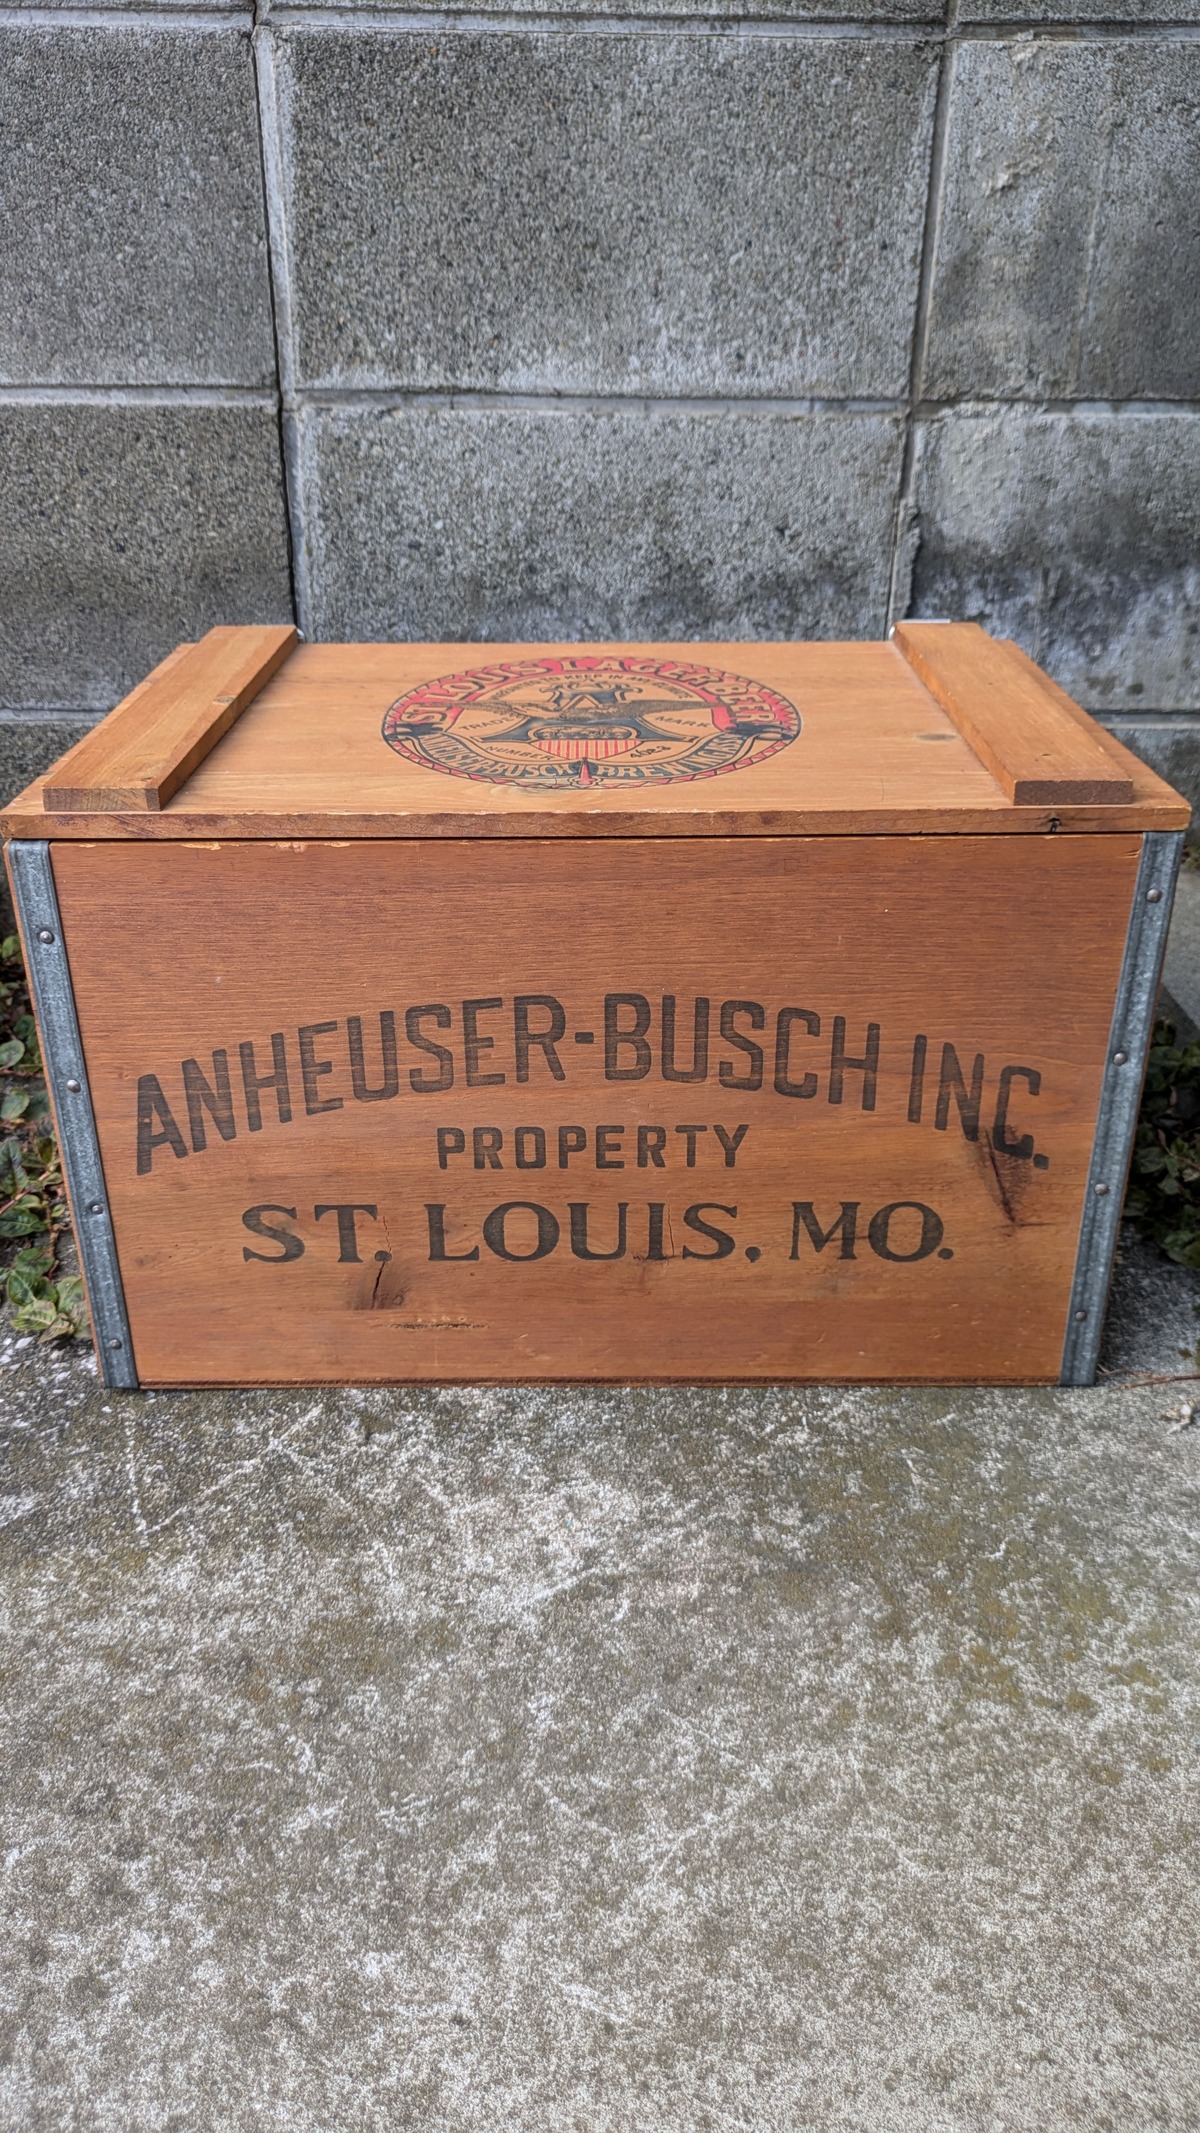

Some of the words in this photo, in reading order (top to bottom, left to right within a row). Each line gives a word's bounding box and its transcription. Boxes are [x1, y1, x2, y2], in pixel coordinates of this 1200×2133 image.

[425, 661, 554, 702] LOUIS
[562, 659, 722, 687] LAGER
[702, 680, 776, 723] BEER
[564, 673, 602, 681] KEEP
[459, 716, 515, 731] TRADE
[654, 716, 711, 728] MARK
[485, 746, 556, 760] NUMBER
[136, 992, 881, 1175] ANHEUSER-BUSCH
[908, 1033, 1049, 1169] INC.
[437, 1124, 750, 1170] PROPERTY
[242, 1204, 392, 1263] ST.
[789, 1201, 954, 1263] MO.
